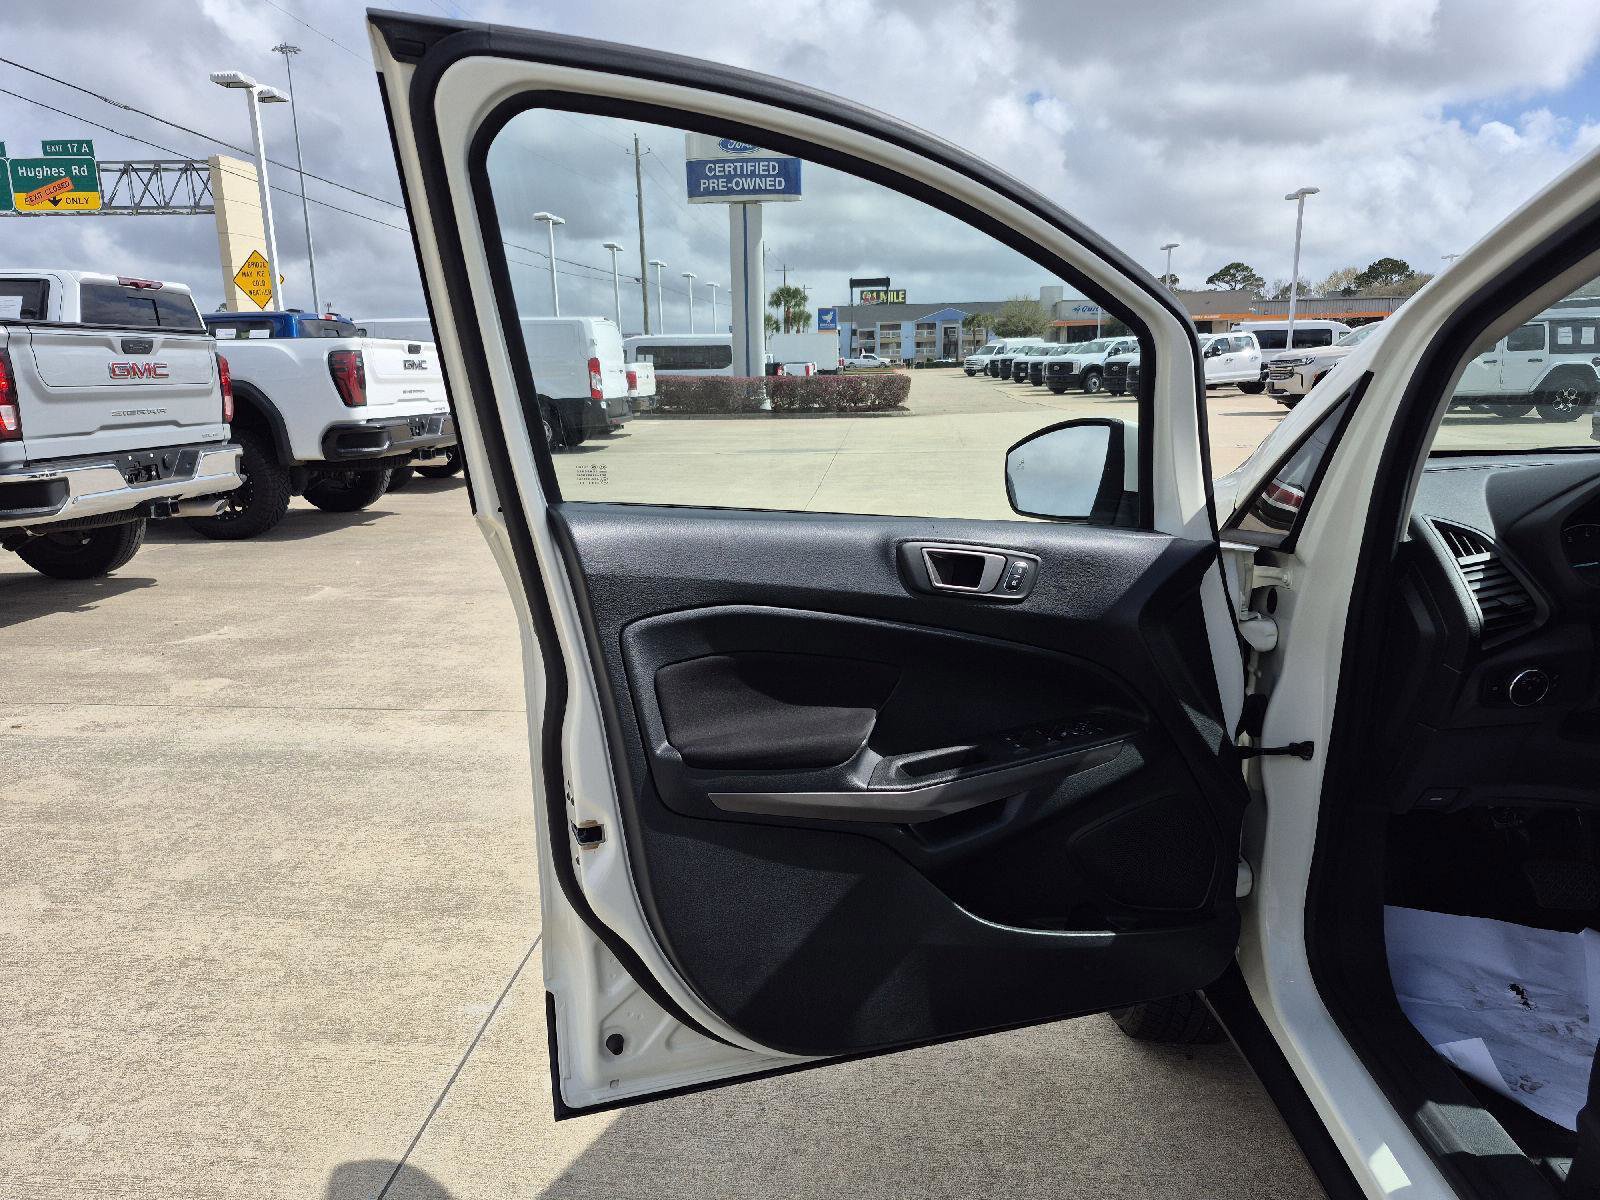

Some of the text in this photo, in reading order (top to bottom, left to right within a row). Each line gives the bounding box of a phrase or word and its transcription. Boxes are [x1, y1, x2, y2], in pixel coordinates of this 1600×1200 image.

[46, 143, 89, 153] EXIT 17 A
[17, 165, 88, 179] Hughes Rd
[705, 161, 779, 176] CERTIFIED
[44, 180, 71, 196] CLOSED
[700, 178, 785, 191] PRE-OWNED
[65, 197, 89, 205] ONLY
[108, 361, 170, 380] GMC
[403, 359, 428, 370] GMC
